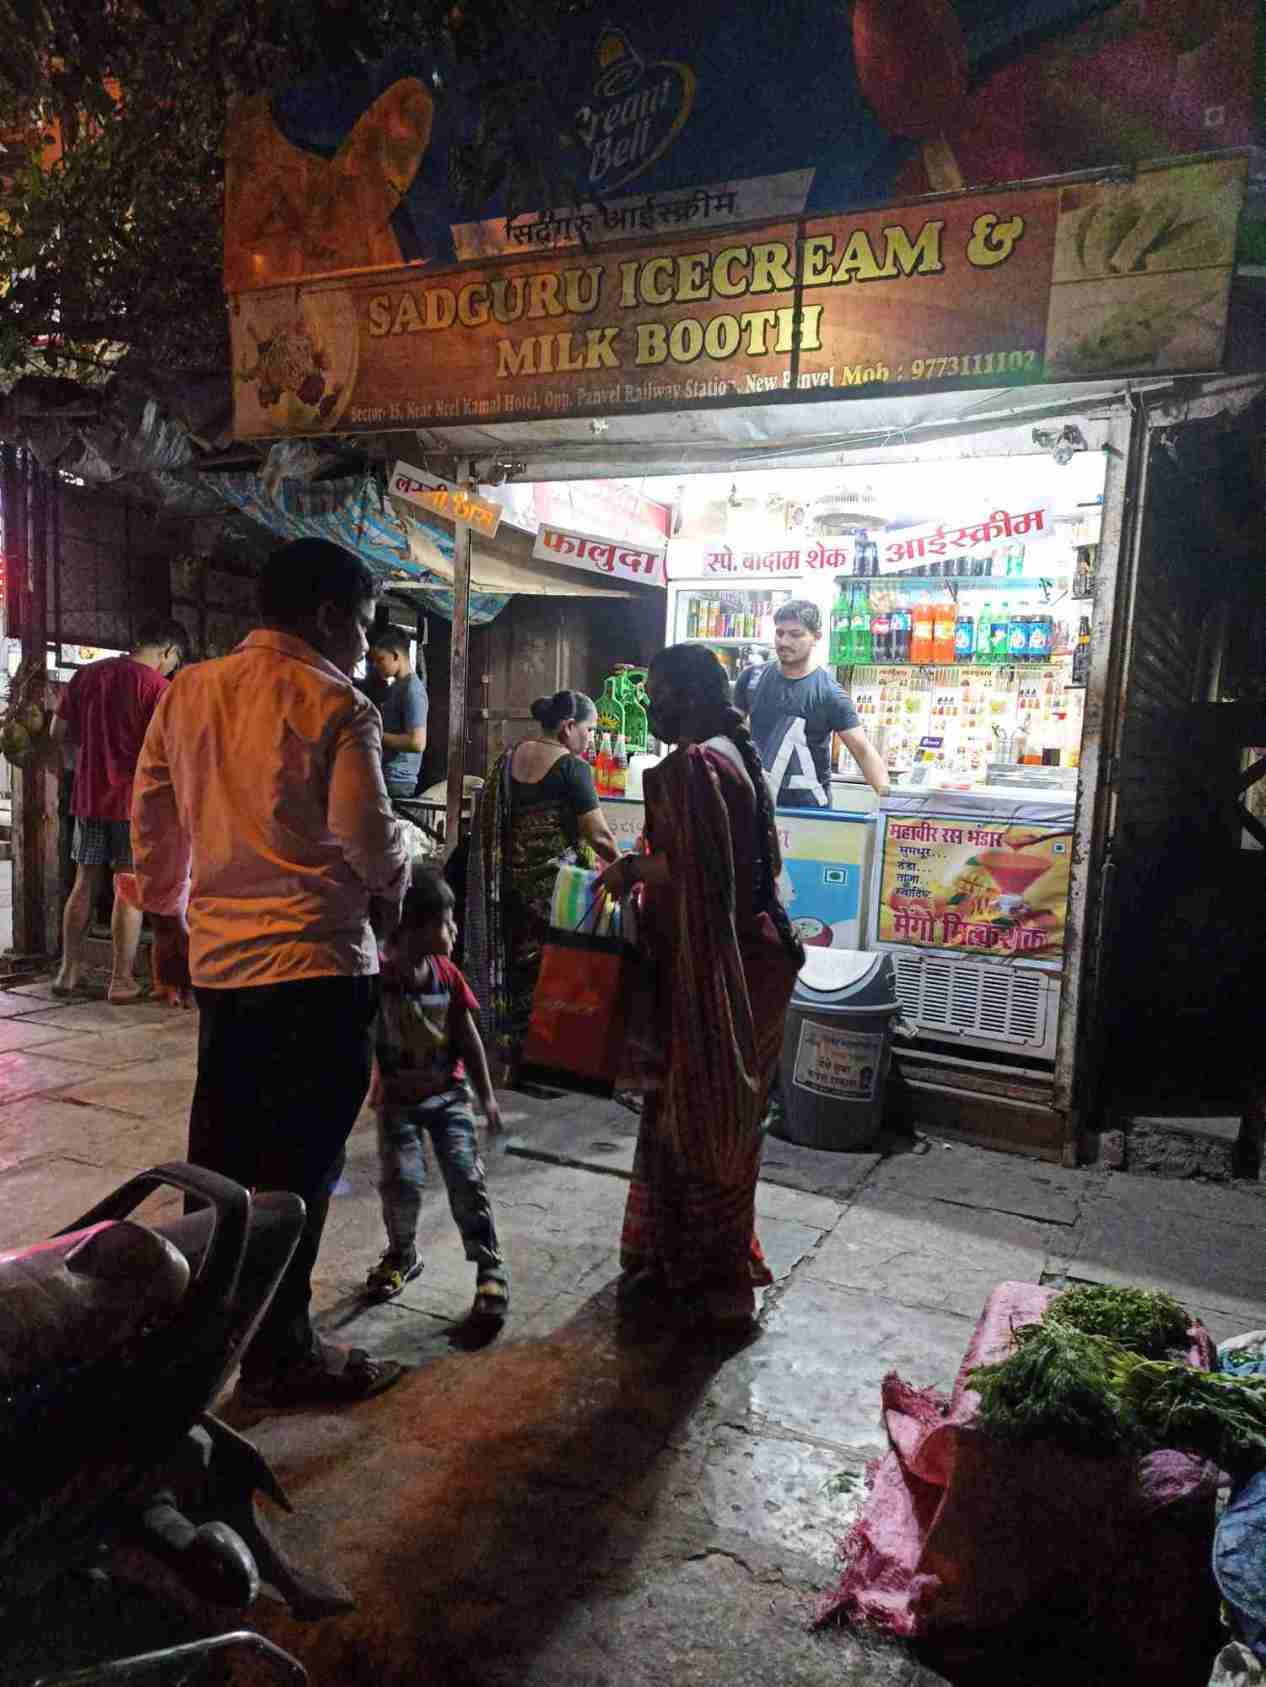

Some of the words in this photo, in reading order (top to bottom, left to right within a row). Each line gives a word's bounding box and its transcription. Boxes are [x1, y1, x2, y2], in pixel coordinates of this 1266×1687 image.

[368, 266, 604, 337] SADGURU
[618, 221, 945, 308] ICECREAM
[965, 214, 1024, 268] &
[496, 326, 622, 377] MILK
[634, 304, 824, 366] BOOTH
[577, 384, 620, 407] Panvel
[624, 380, 682, 402] Railway
[742, 372, 779, 393] New
[782, 366, 835, 389] Pnvel
[840, 362, 890, 386] Mob
[543, 530, 659, 574] फालुदा
[806, 541, 848, 569] शेक
[885, 509, 1045, 563] आईस्क्रीम
[889, 822, 938, 843] महावीर
[941, 828, 962, 845] रस
